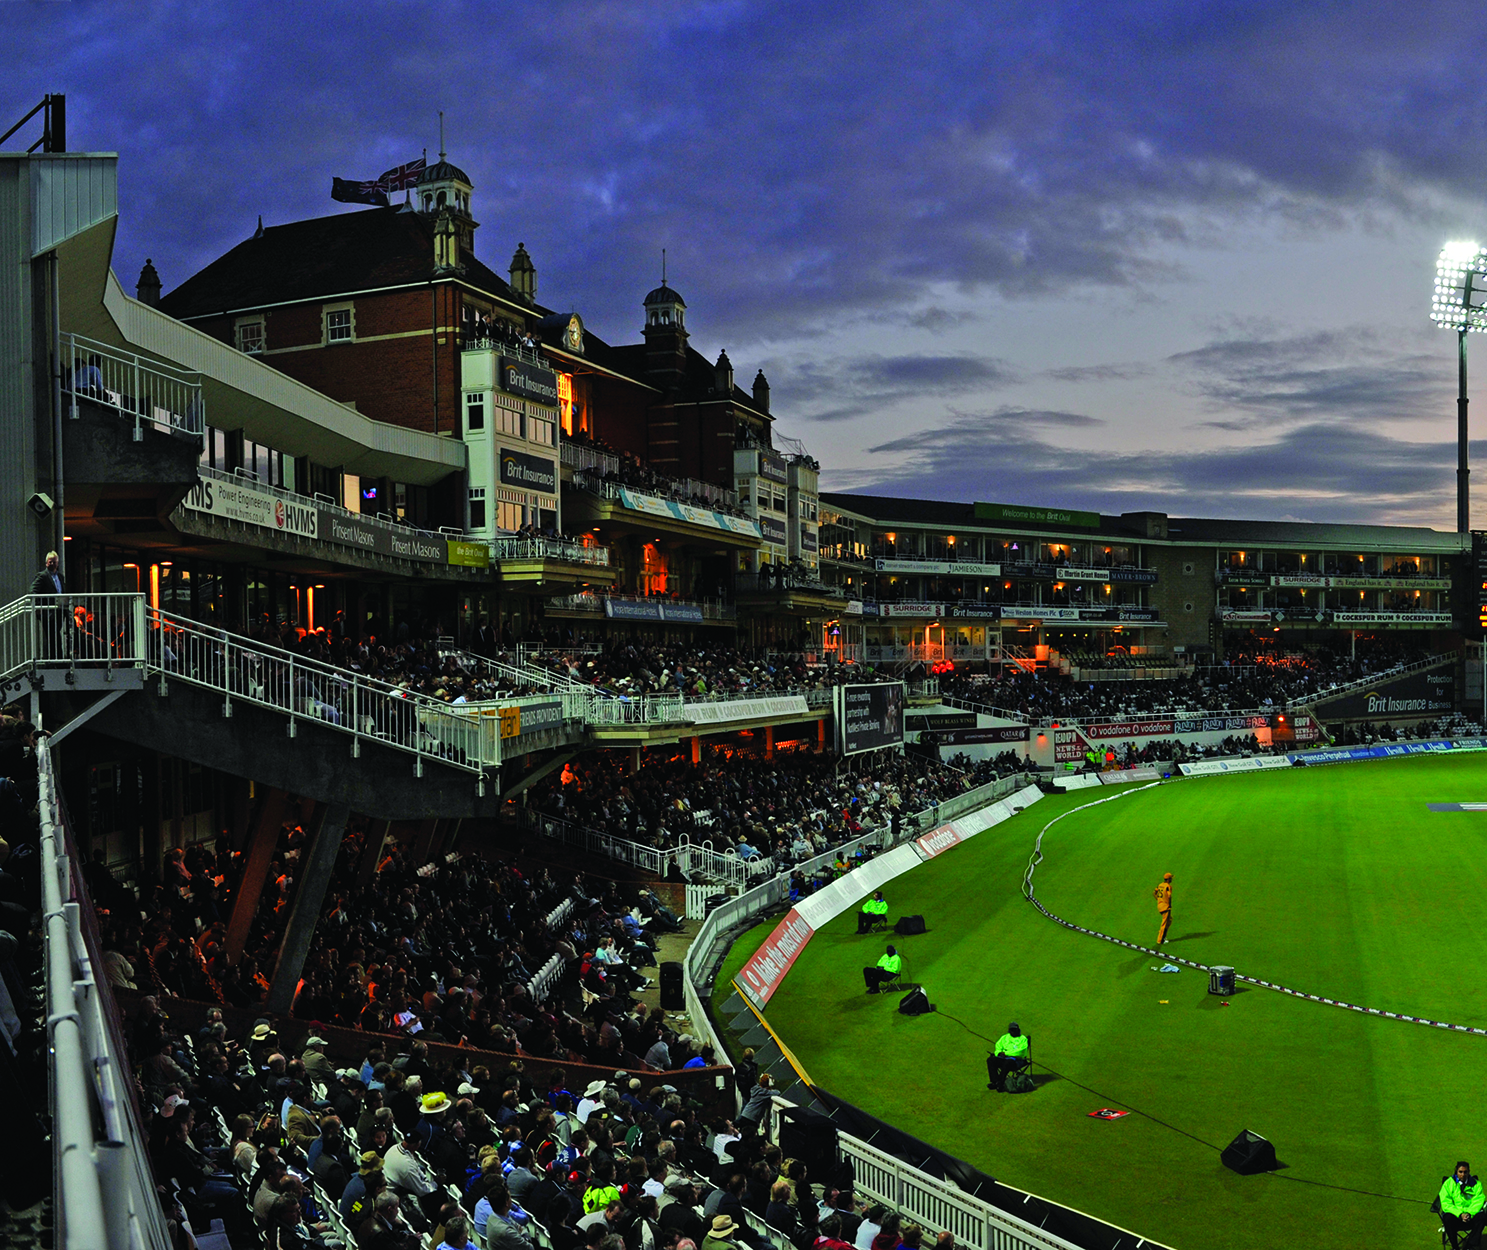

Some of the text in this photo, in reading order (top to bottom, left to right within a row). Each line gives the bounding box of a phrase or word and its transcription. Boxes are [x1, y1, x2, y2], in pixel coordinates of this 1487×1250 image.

[510, 370, 556, 398] Brit Insurance
[507, 462, 554, 486] Brit Insurance
[219, 485, 236, 502] Power
[238, 490, 271, 514] Engineering
[286, 504, 315, 535] HVMS
[332, 519, 440, 558] Pinsent Masons Pinsent Masons
[966, 609, 992, 617] Insurance
[1427, 674, 1453, 684] Protection
[702, 707, 718, 720] RUM
[723, 701, 795, 717] COCKSPUR RUM COCKSPUR
[1368, 696, 1426, 712] Brit Insurance
[1428, 701, 1452, 709] Business
[520, 710, 536, 727] FRIENDS
[537, 707, 561, 723] PROVIDENT
[1098, 726, 1131, 735] vodafone
[1140, 723, 1171, 732] vodafone
[1302, 751, 1351, 762] Invesco Perpetual
[928, 828, 957, 853] vodafone
[786, 920, 804, 944] of
[776, 928, 800, 959] most
[766, 946, 789, 970] the
[751, 956, 781, 987] Make
